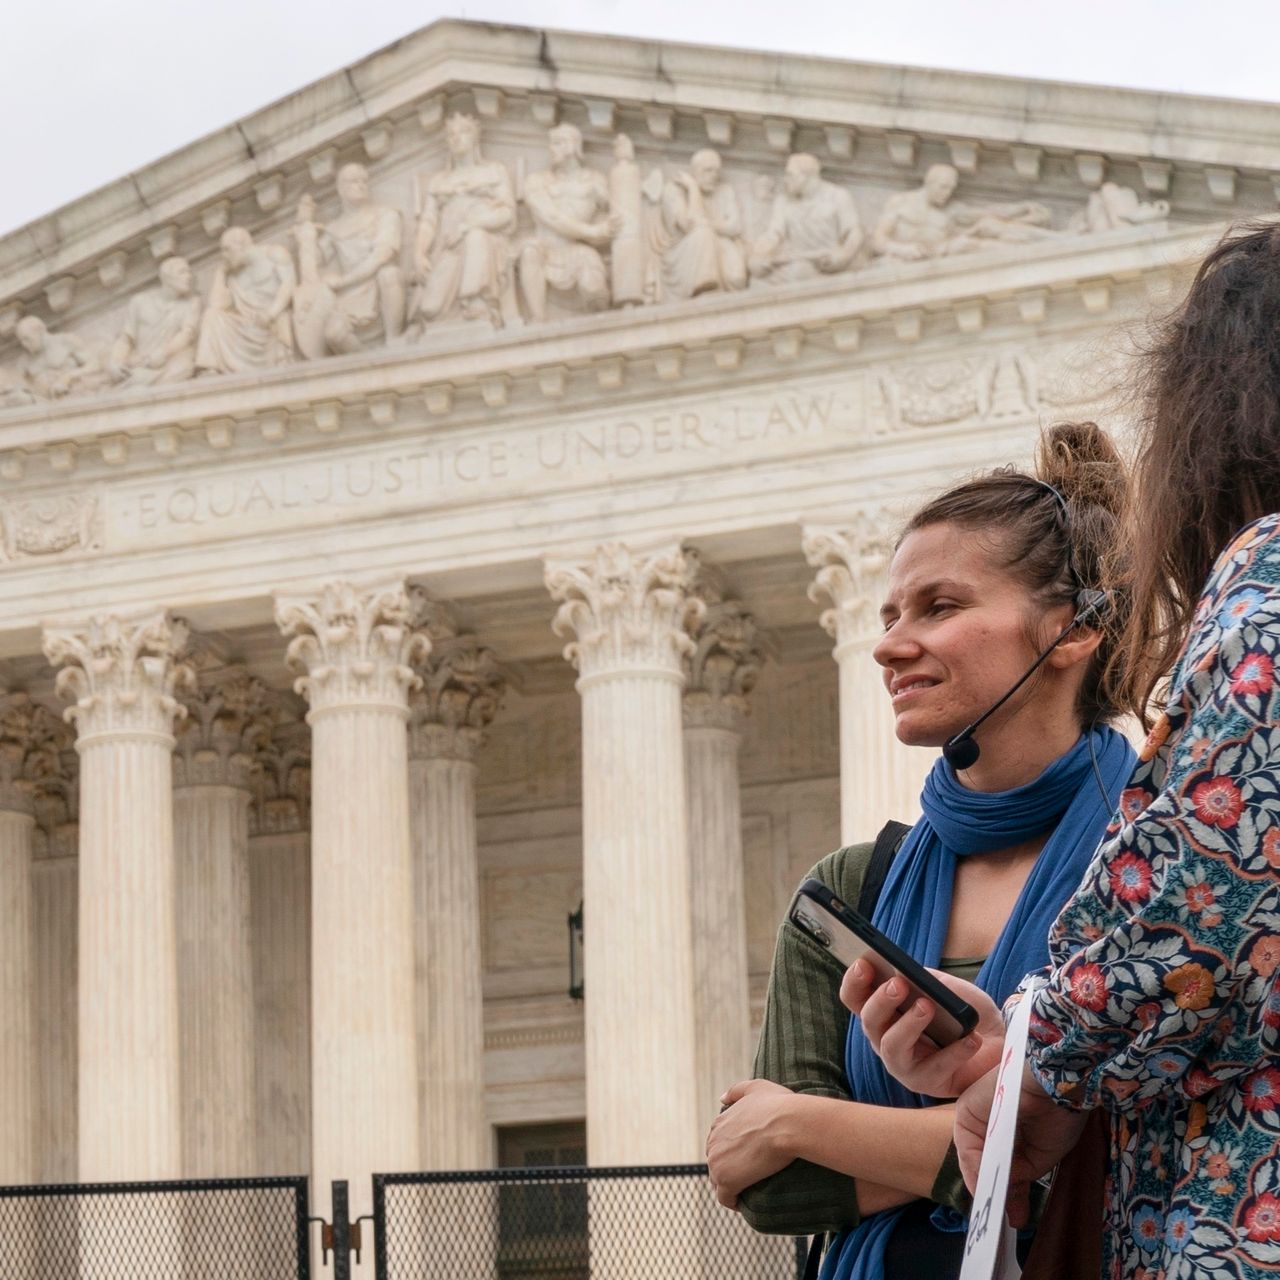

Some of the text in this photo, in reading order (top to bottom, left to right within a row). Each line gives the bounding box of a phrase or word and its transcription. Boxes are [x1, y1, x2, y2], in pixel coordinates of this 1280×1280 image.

[140, 391, 837, 529] EQUAL JUSTICE UNDER LAW
